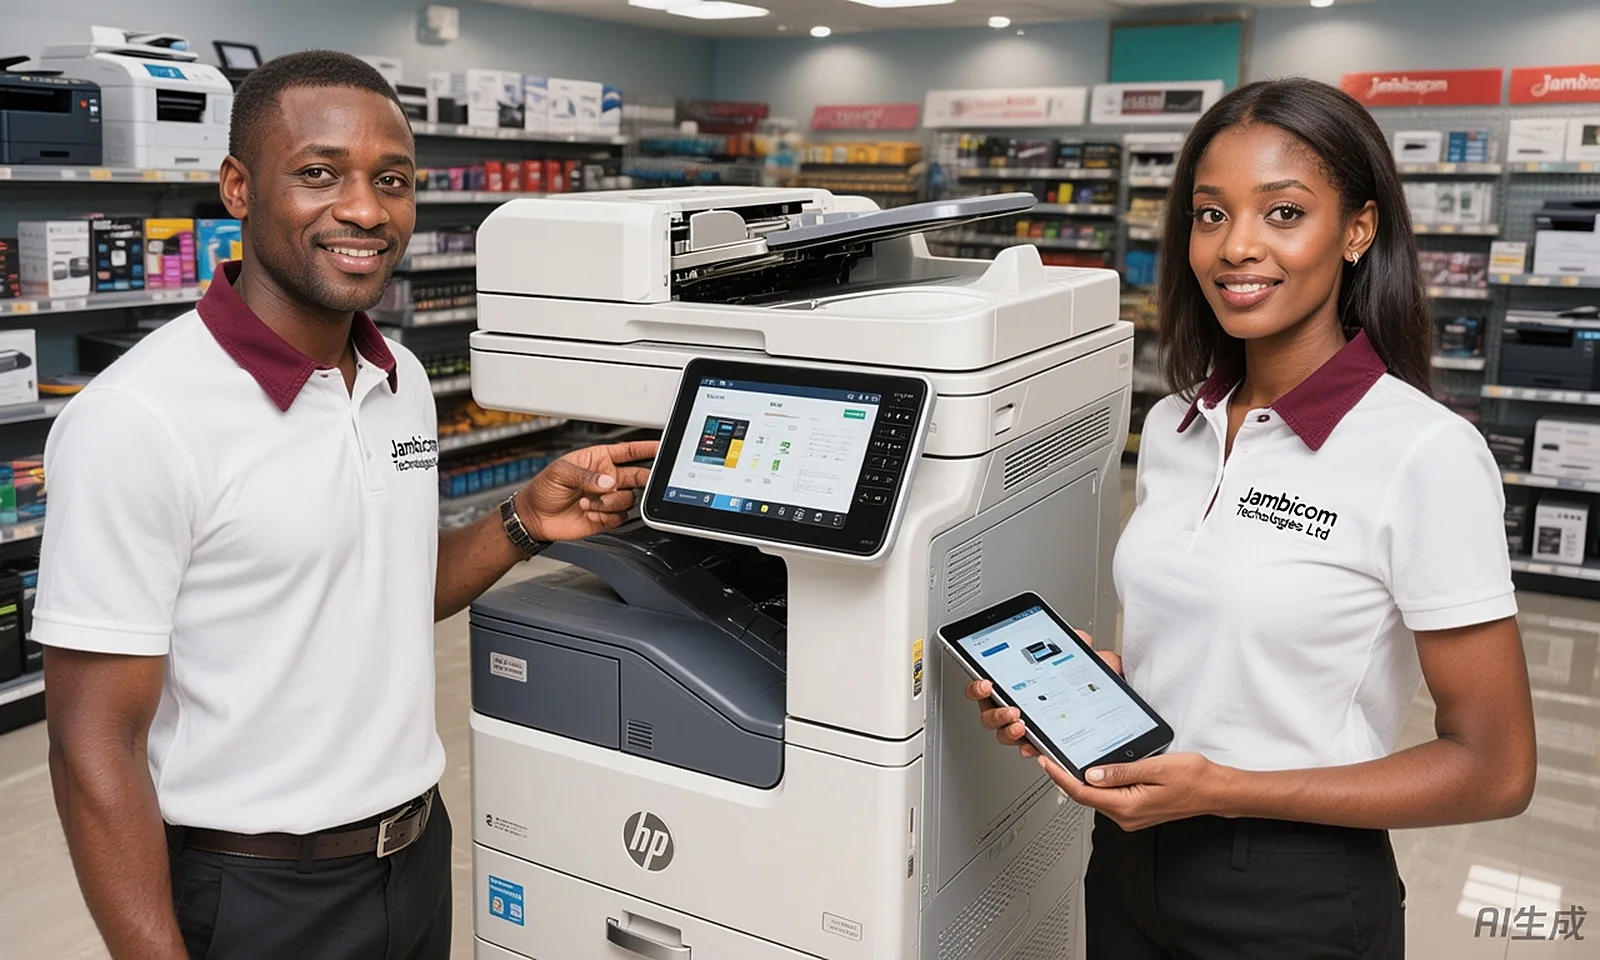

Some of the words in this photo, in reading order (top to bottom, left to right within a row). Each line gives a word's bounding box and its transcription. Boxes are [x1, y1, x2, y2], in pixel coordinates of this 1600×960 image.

[1239, 486, 1338, 527] Jambicom
[1305, 522, 1331, 541] Ltd
[628, 810, 670, 871] hp
